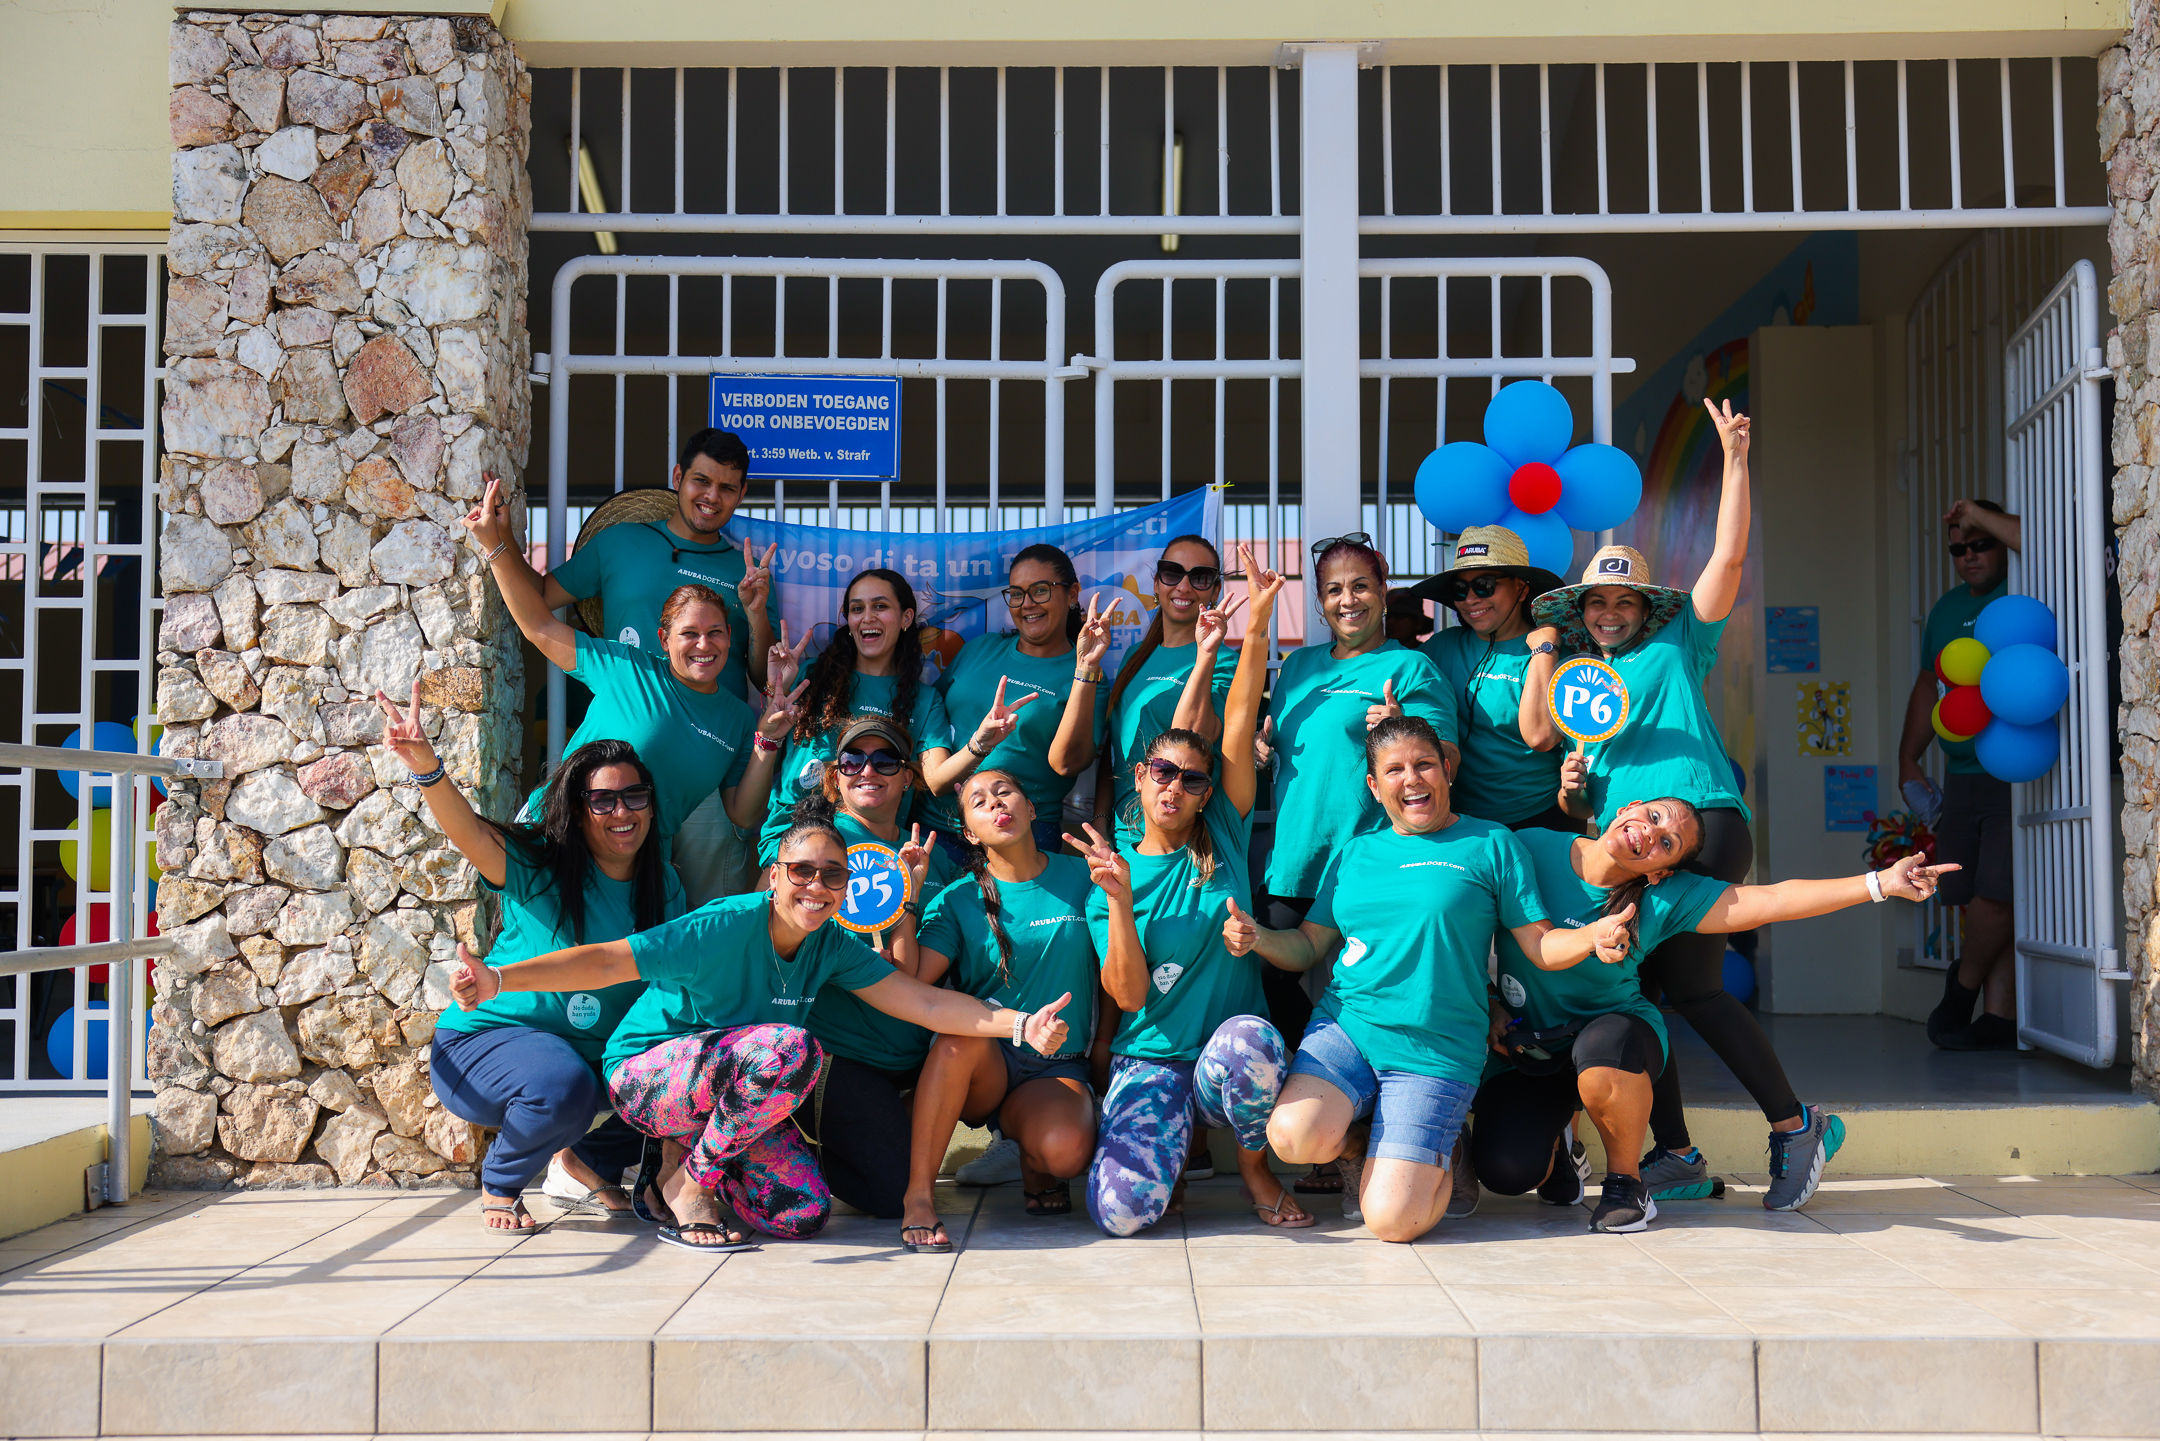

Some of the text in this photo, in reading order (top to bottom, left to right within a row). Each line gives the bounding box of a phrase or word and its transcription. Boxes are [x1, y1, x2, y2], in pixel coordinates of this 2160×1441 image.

[721, 393, 890, 410] VERBODEN TOEGANG
[721, 414, 890, 431] VOOR ONBEVOEGDEN
[761, 448, 786, 459] 3:59
[788, 448, 821, 460] Wetb.
[824, 451, 834, 460] v.
[836, 449, 871, 461] Strafr
[862, 549, 895, 571] di
[903, 553, 940, 577] ta
[947, 558, 993, 577] un
[677, 568, 735, 590] ARUBADOET.com
[1563, 685, 1612, 724] P6
[846, 871, 893, 914] P5
